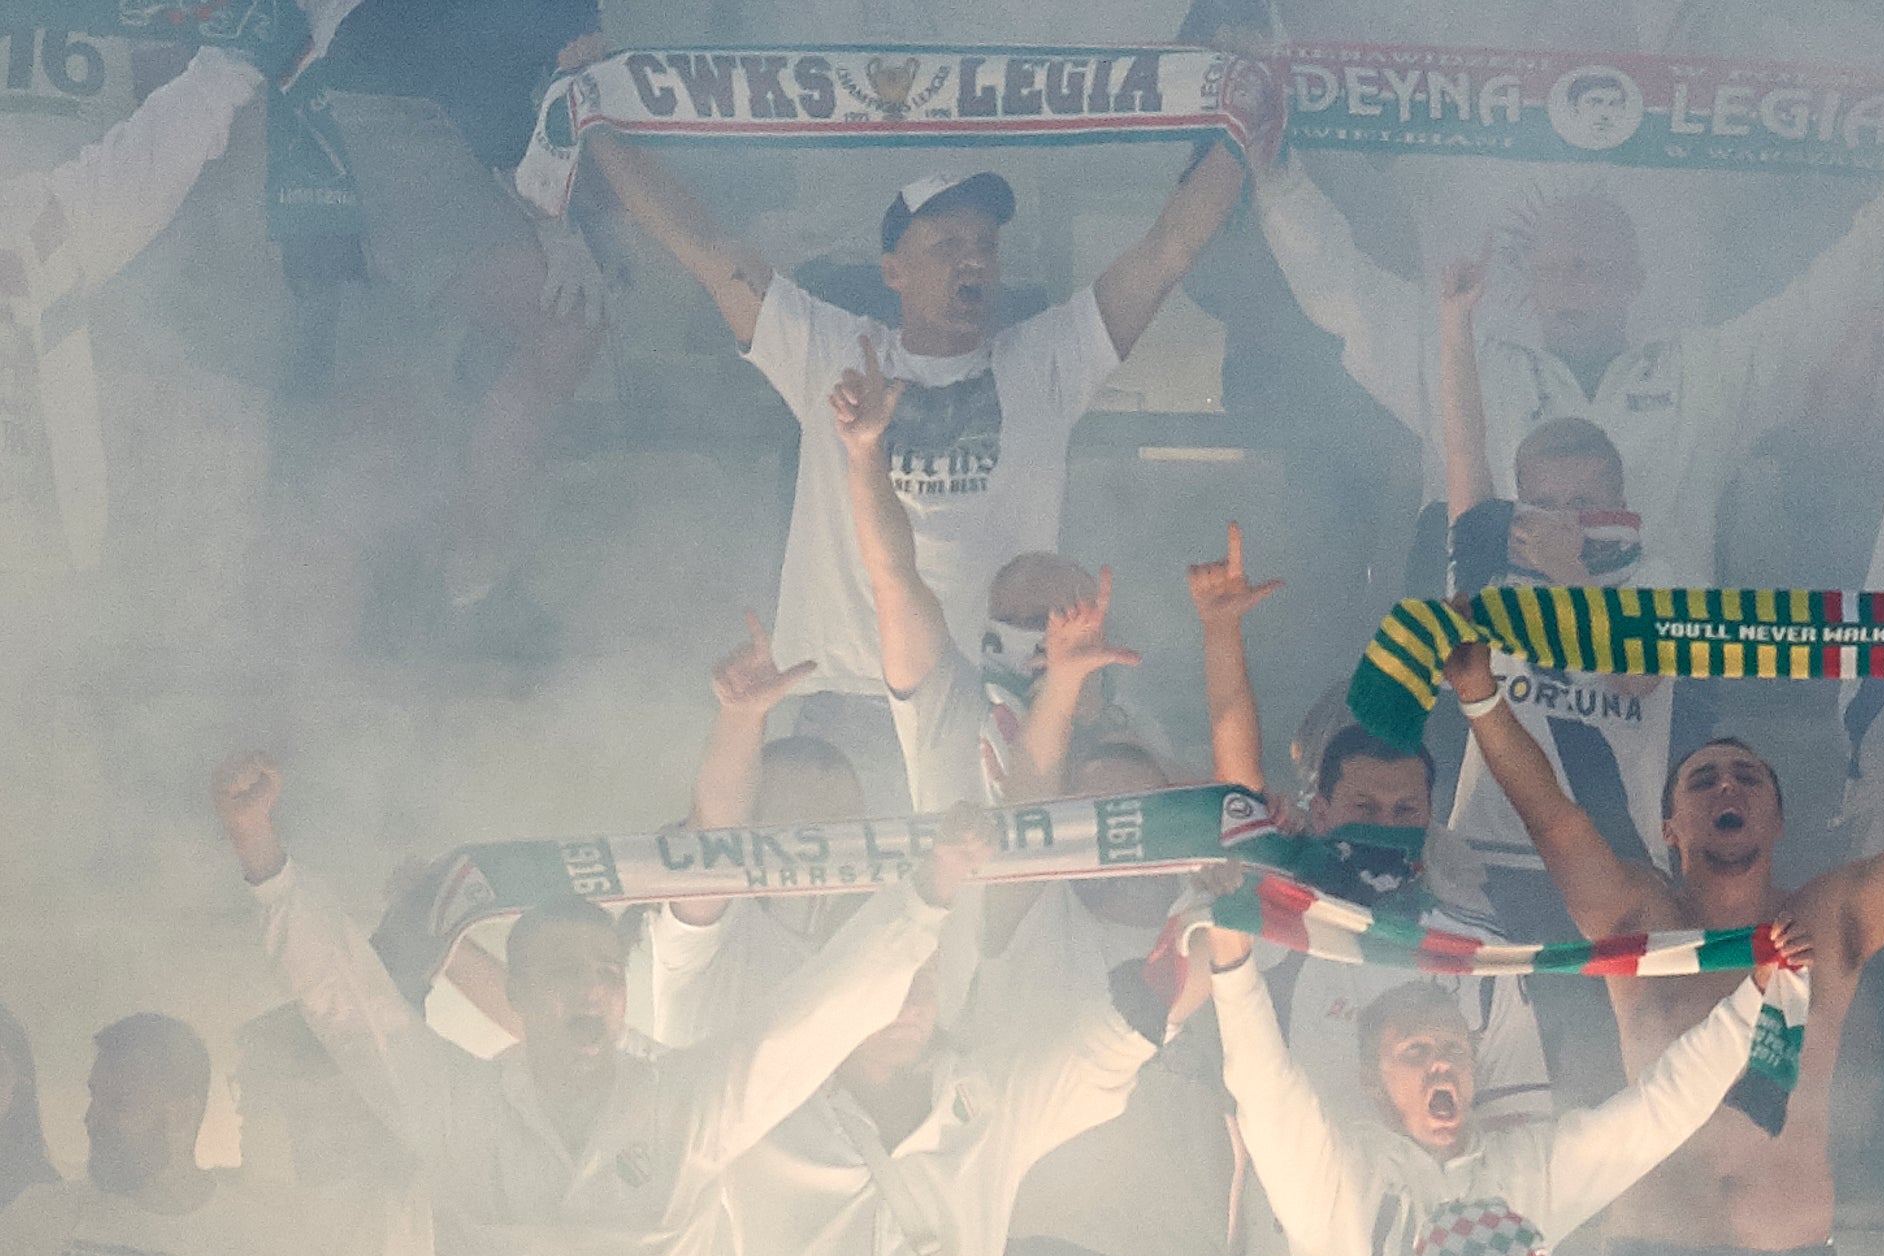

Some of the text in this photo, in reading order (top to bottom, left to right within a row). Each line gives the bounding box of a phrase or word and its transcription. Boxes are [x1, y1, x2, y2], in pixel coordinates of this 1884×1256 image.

[623, 52, 839, 120] CWKS
[957, 55, 1163, 118] LEGIA
[1290, 63, 1523, 128] DEYNA
[949, 477, 988, 494] BEST
[1739, 624, 1817, 643] NEVER
[1494, 674, 1643, 722] ORUNA
[862, 805, 1056, 866] LEIA
